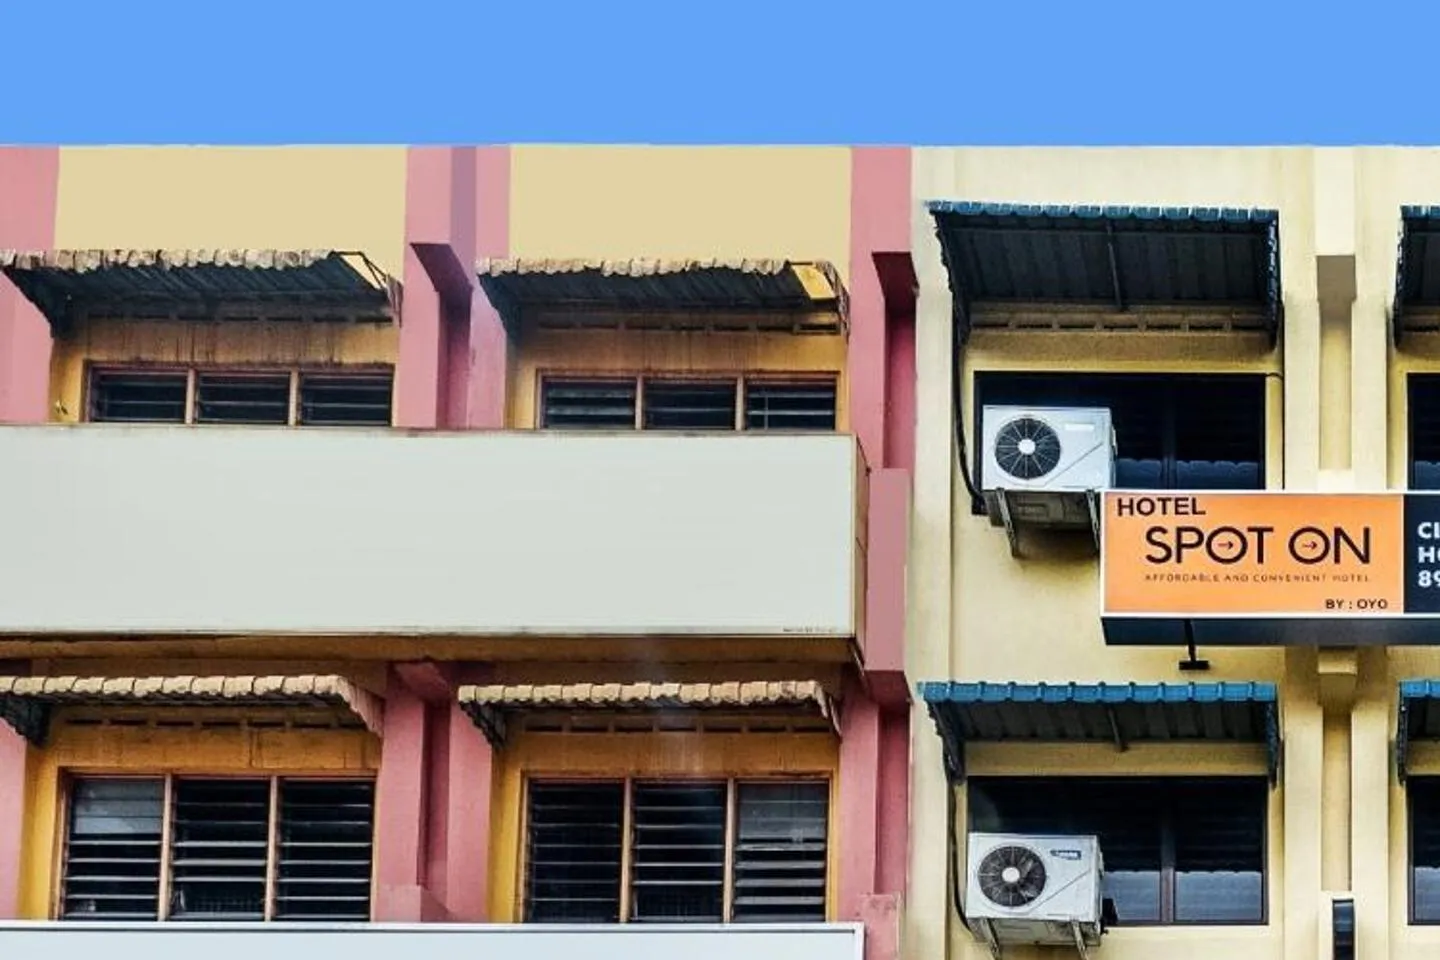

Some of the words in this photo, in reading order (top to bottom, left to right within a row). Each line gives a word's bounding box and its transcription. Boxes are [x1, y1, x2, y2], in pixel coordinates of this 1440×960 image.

[1117, 497, 1206, 517] HOTEL
[1145, 525, 1274, 565] SPOT
[1288, 525, 1371, 565] ON
[1145, 573, 1220, 583] AFFORDABLE
[1223, 573, 1249, 583] AND
[1252, 573, 1327, 583] CONVENIENT
[1332, 573, 1370, 583] HOTEL
[1325, 598, 1345, 610] BY
[1356, 598, 1389, 610] OYO
